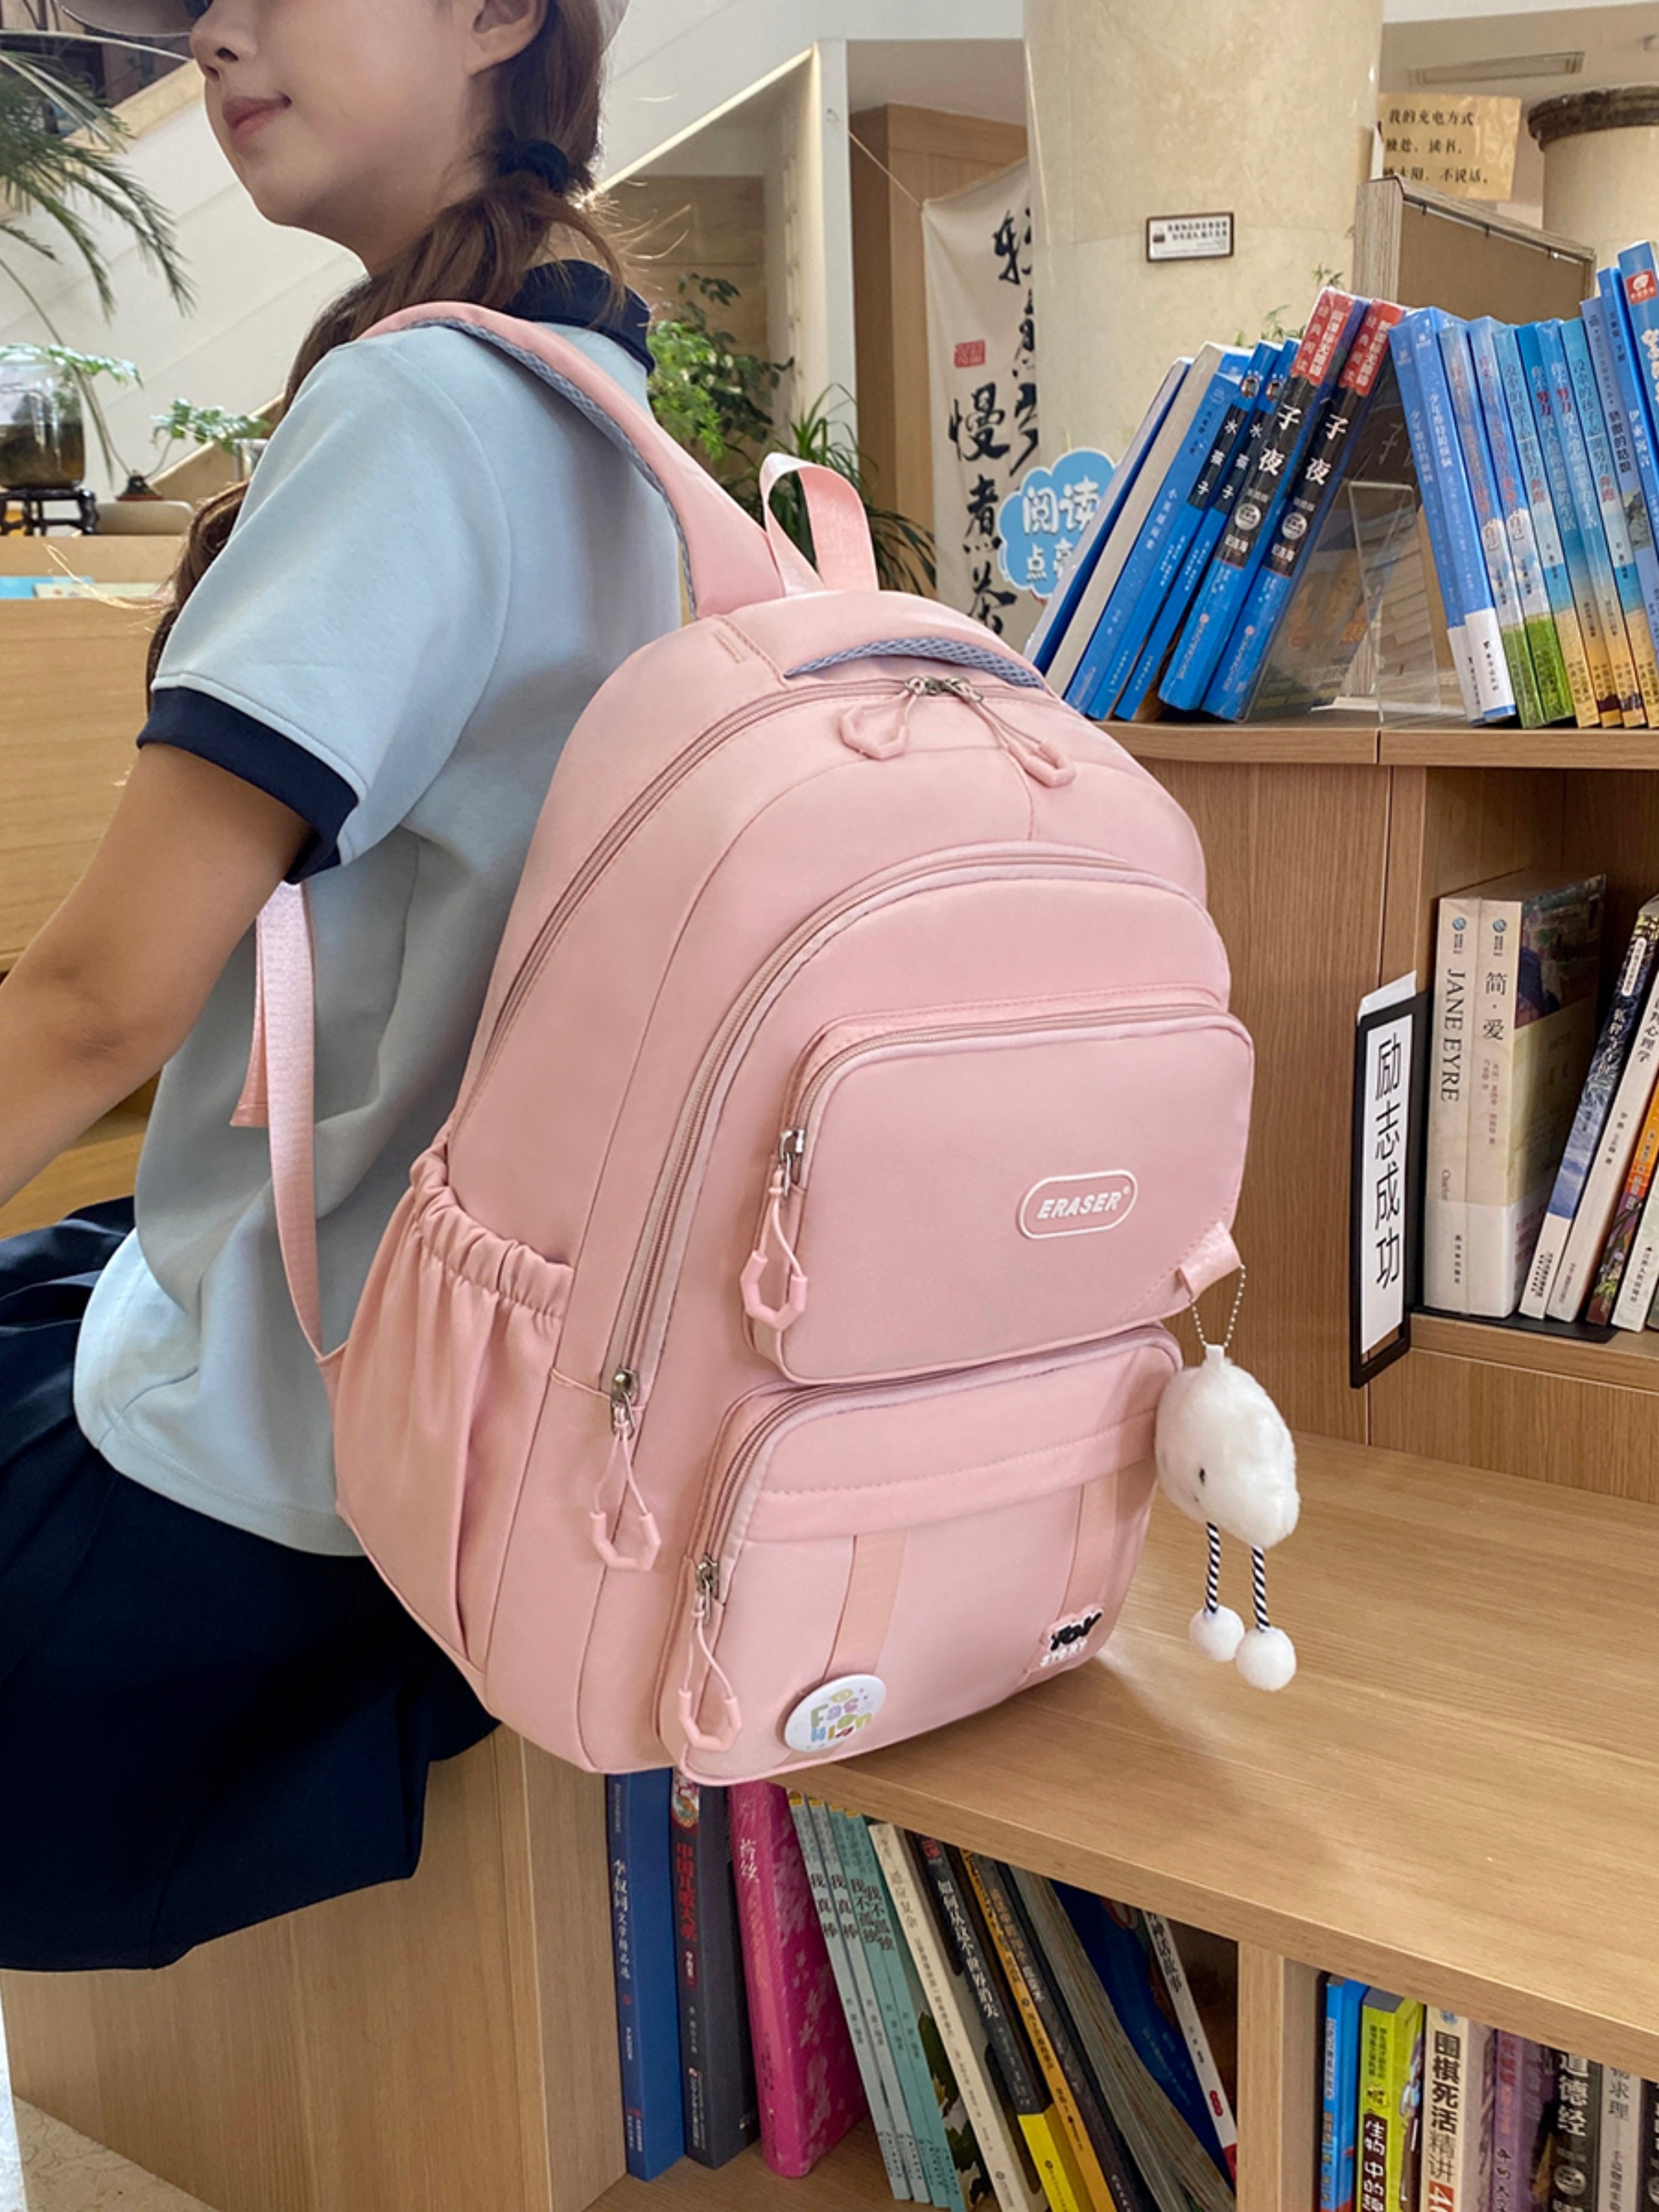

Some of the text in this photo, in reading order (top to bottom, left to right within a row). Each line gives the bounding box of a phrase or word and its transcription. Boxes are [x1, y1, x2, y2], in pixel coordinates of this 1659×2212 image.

[1258, 405, 1302, 476] 子夜
[1305, 414, 1350, 486] 子夜
[1023, 474, 1099, 535] 阅读
[1442, 969, 1465, 1102] JANE EYRE
[1483, 972, 1507, 1040] 简·爱
[1375, 1032, 1401, 1289] 励志成功
[1036, 1192, 1122, 1219] ERASER
[810, 1874, 837, 1938] 我真棒
[830, 1874, 859, 1940] 我真棒
[1428, 2031, 1461, 2182] 围棋死活精讲
